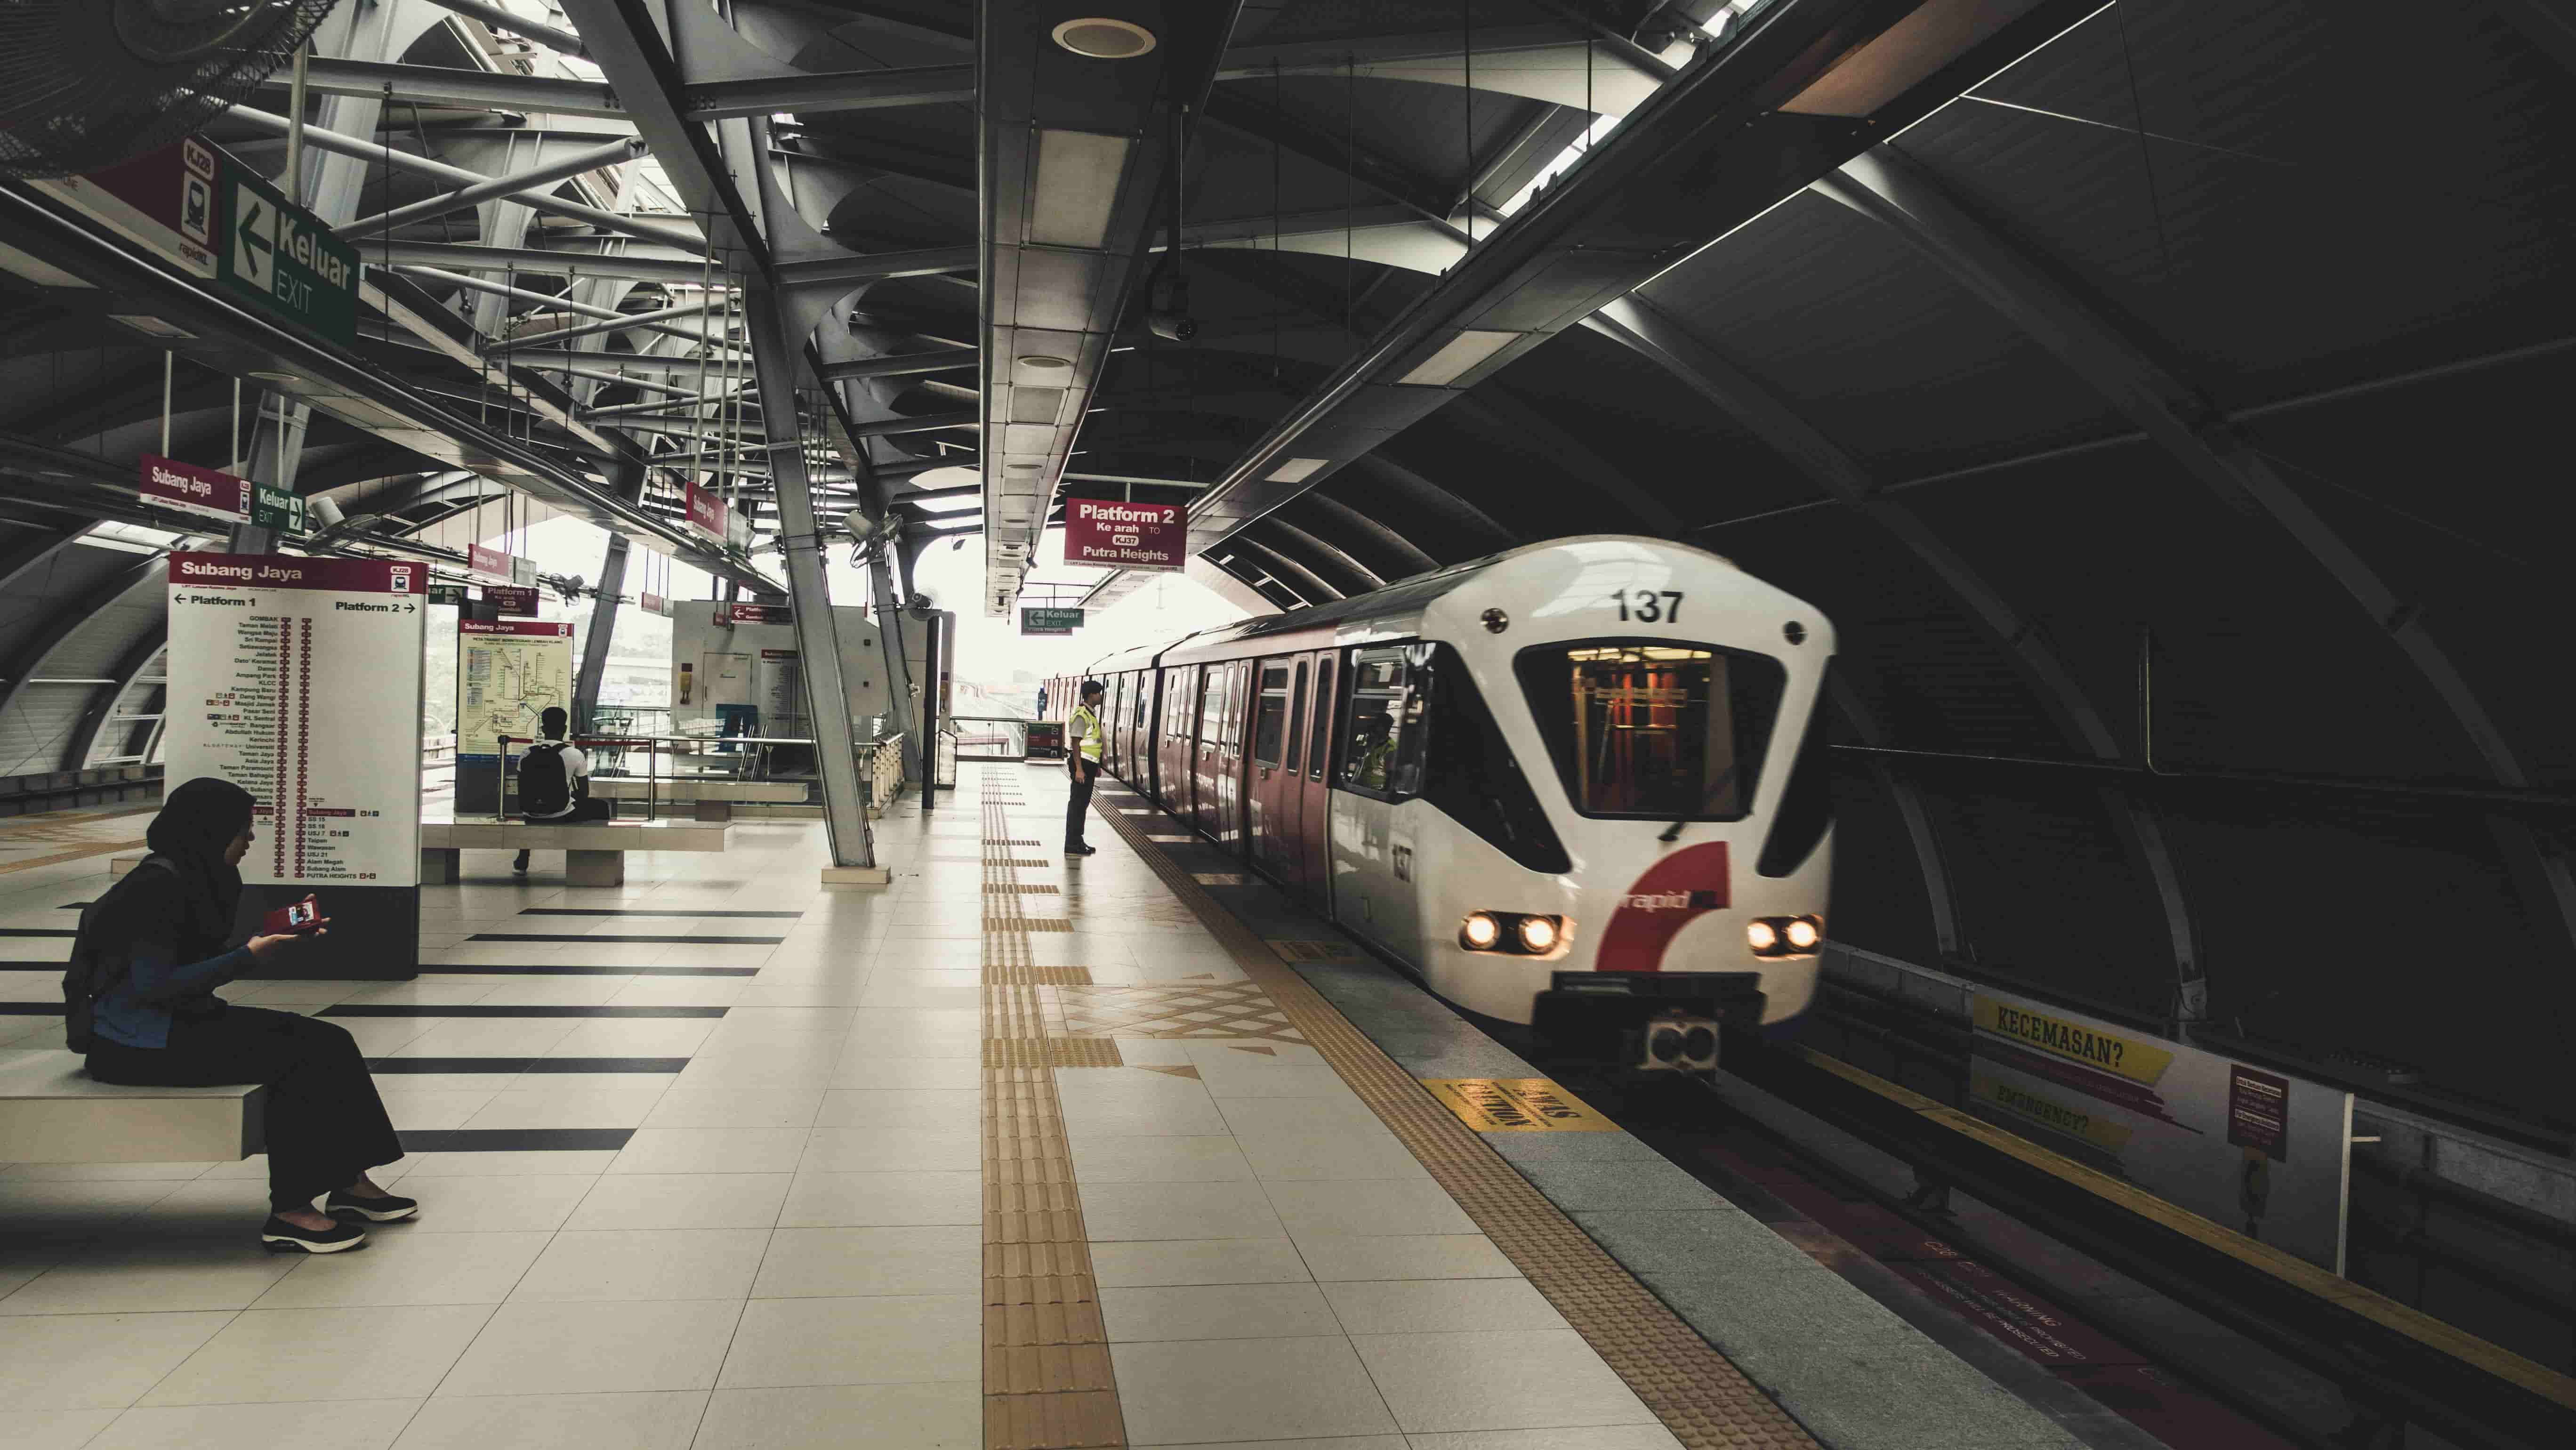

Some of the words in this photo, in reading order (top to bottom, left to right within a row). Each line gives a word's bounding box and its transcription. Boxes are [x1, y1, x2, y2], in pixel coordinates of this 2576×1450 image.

[280, 211, 350, 290] Keluar
[277, 269, 313, 314] EXIT
[152, 466, 188, 493] Subang
[190, 476, 211, 497] Jaya
[260, 488, 288, 509] Keluar
[259, 511, 274, 523] EXIT
[1079, 504, 1158, 523] Platform
[1162, 509, 1175, 524] 2
[1096, 522, 1111, 532] Ke
[1114, 524, 1139, 533] arah
[1149, 527, 1160, 535] TO
[1083, 546, 1117, 558] Putra
[1121, 548, 1169, 562] Heights
[182, 562, 253, 580] Subang
[258, 565, 302, 582] Jaya
[191, 596, 245, 606] Platform
[249, 598, 256, 606] 1
[488, 587, 525, 596] Platform
[336, 602, 388, 612] Platform
[392, 604, 400, 612] 2
[1046, 610, 1079, 618] Keluar
[1611, 588, 1685, 624] 137
[465, 623, 494, 631] Subang
[1997, 1005, 2124, 1068] KECEMASAN?
[1997, 1085, 2089, 1133] EMERGENCY?
